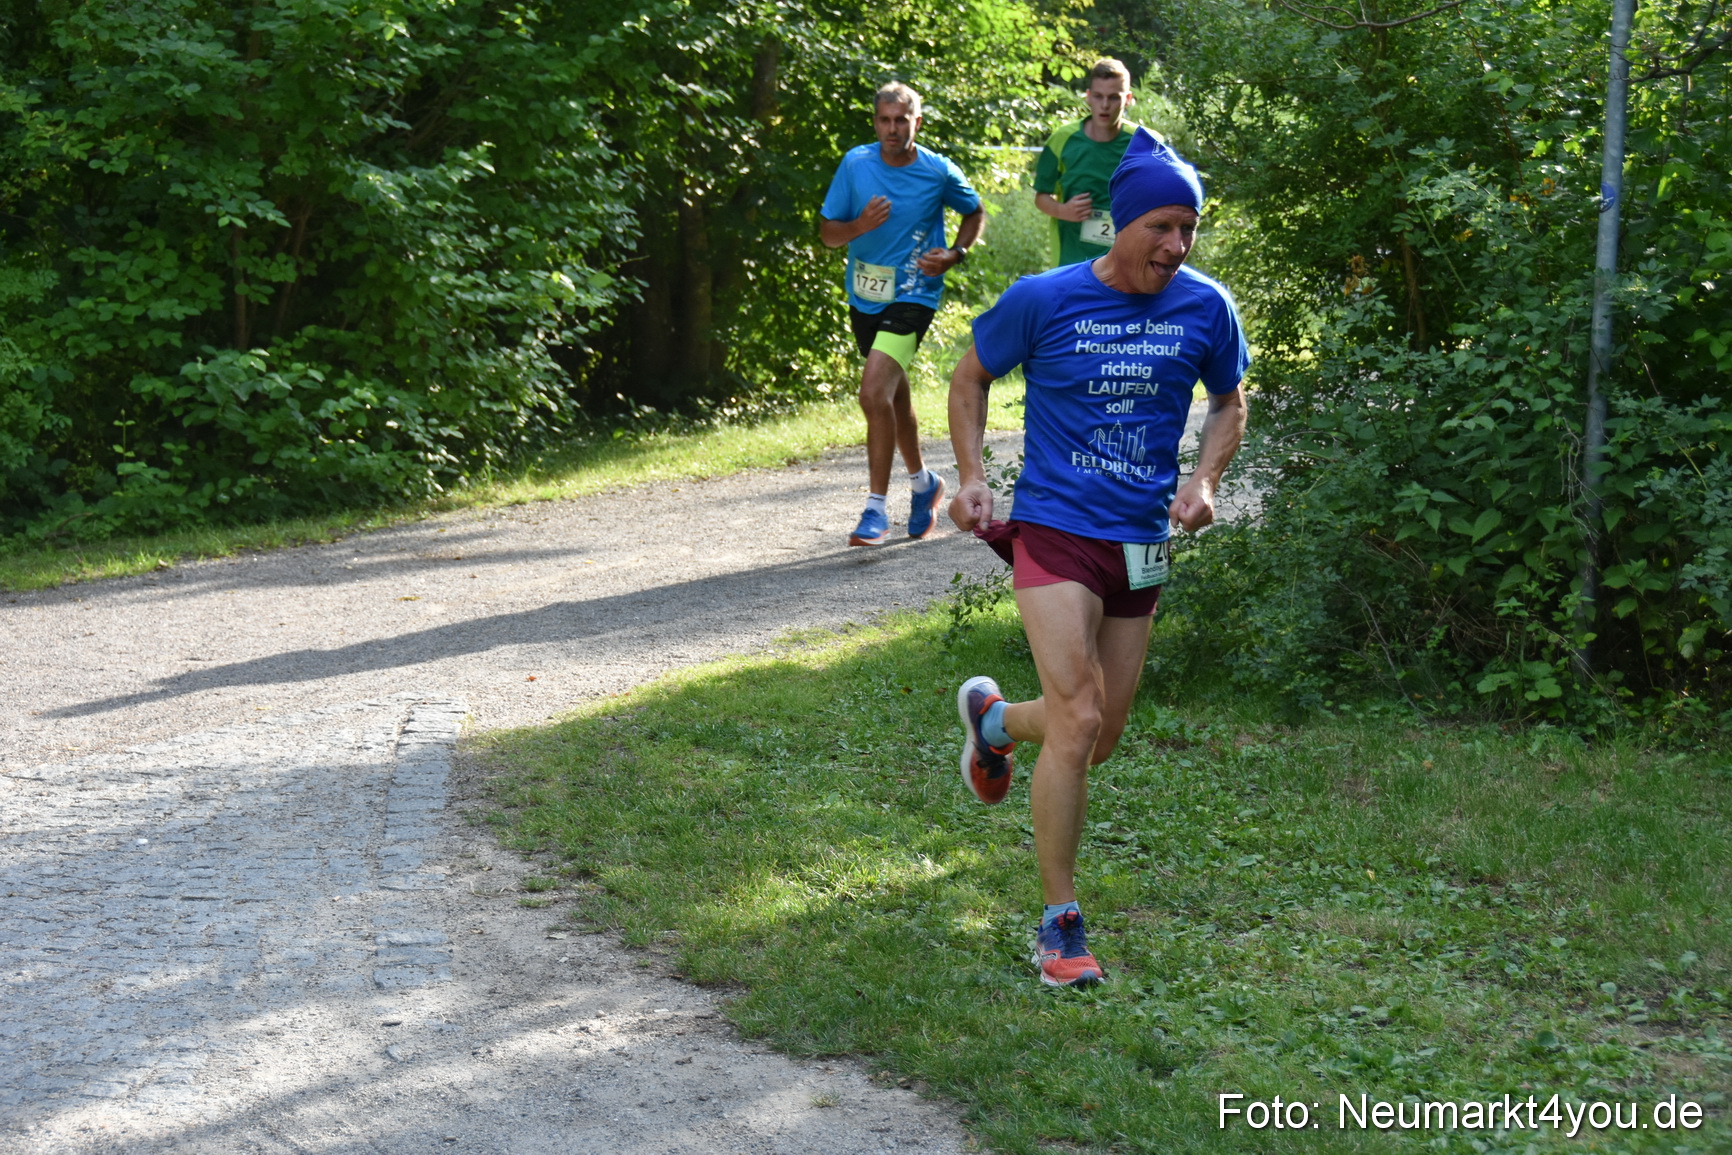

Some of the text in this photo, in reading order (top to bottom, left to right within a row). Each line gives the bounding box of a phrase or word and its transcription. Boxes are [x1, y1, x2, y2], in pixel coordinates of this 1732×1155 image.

[1101, 223, 1110, 236] 2
[856, 273, 888, 292] 1727
[1075, 319, 1184, 336] Wenn es beim
[1075, 340, 1181, 357] Hausverkauf
[1101, 361, 1152, 379] richtig
[1088, 381, 1158, 396] LAUFEN
[1105, 399, 1134, 414] soll!
[1072, 451, 1156, 477] FELDBUSCH
